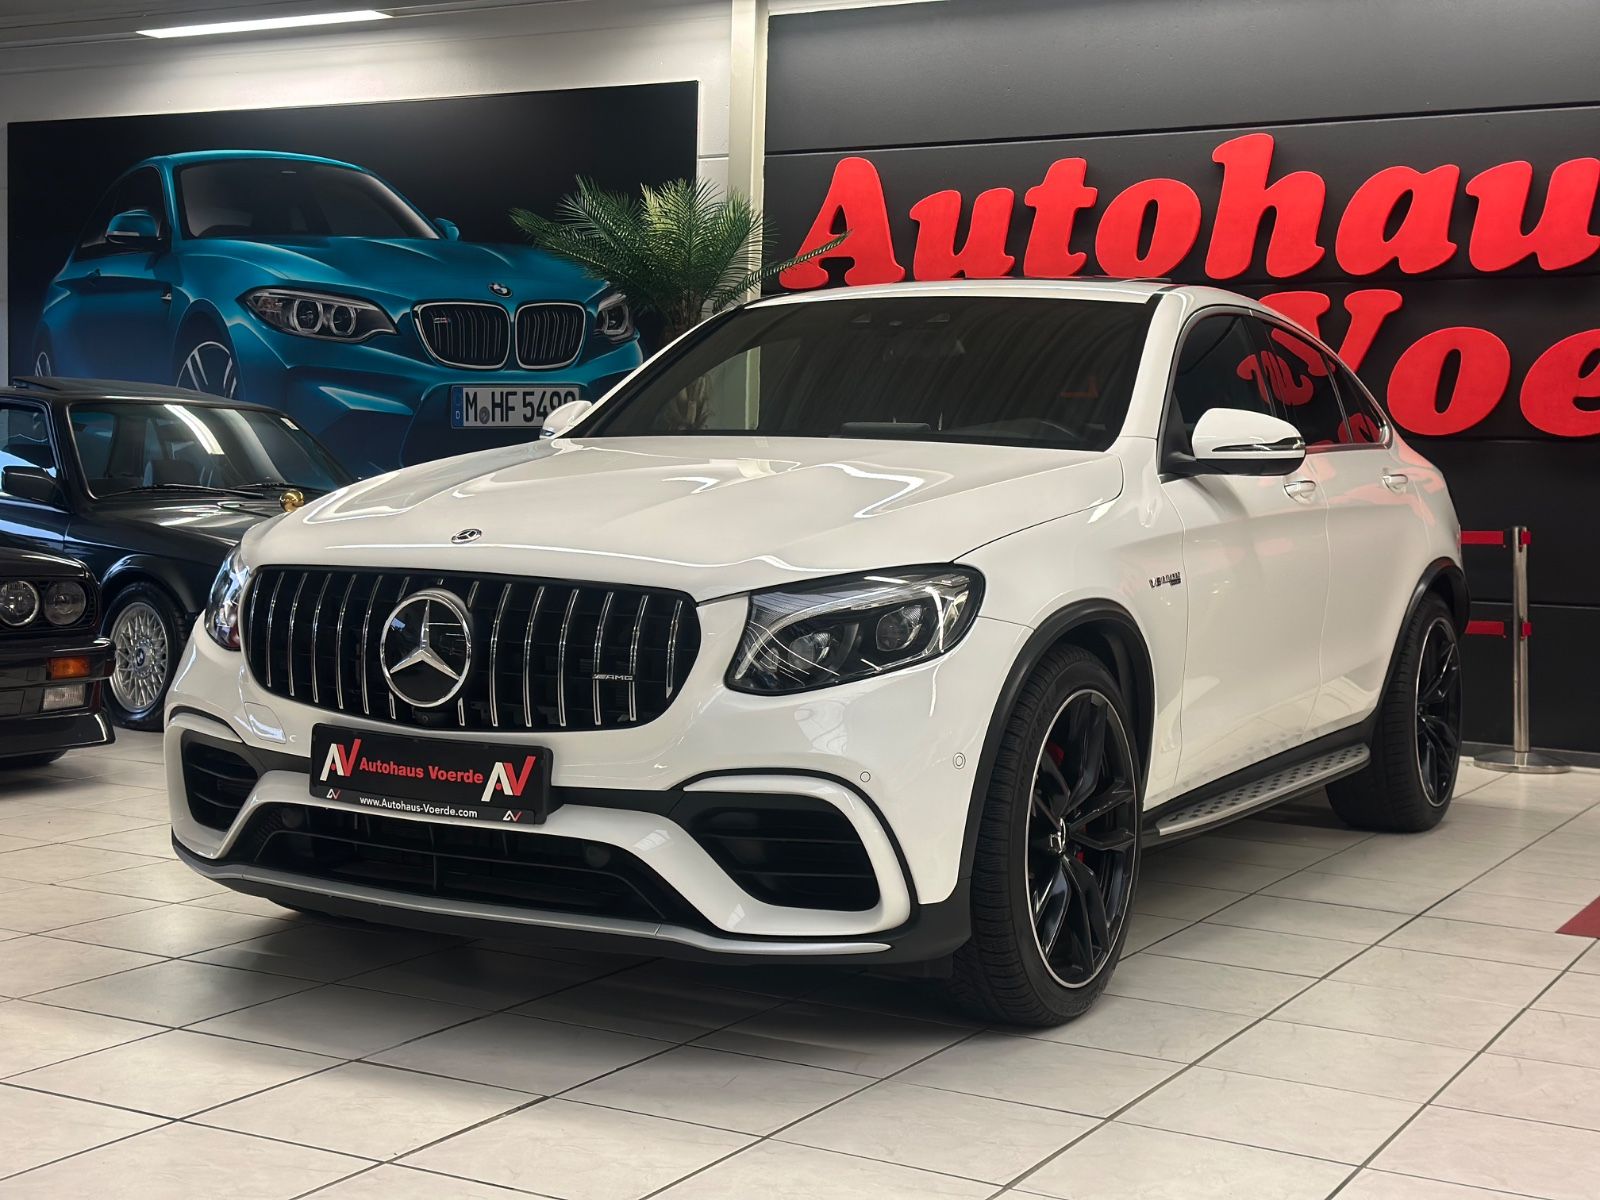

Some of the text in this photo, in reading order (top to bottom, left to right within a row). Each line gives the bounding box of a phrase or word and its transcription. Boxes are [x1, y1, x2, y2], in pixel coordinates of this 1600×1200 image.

[465, 391, 478, 422] M
[491, 391, 518, 422] HF
[360, 757, 425, 778] Autohaus
[428, 765, 484, 784] Voerde
[360, 797, 478, 818] www.Autohaus-Voerde.com
